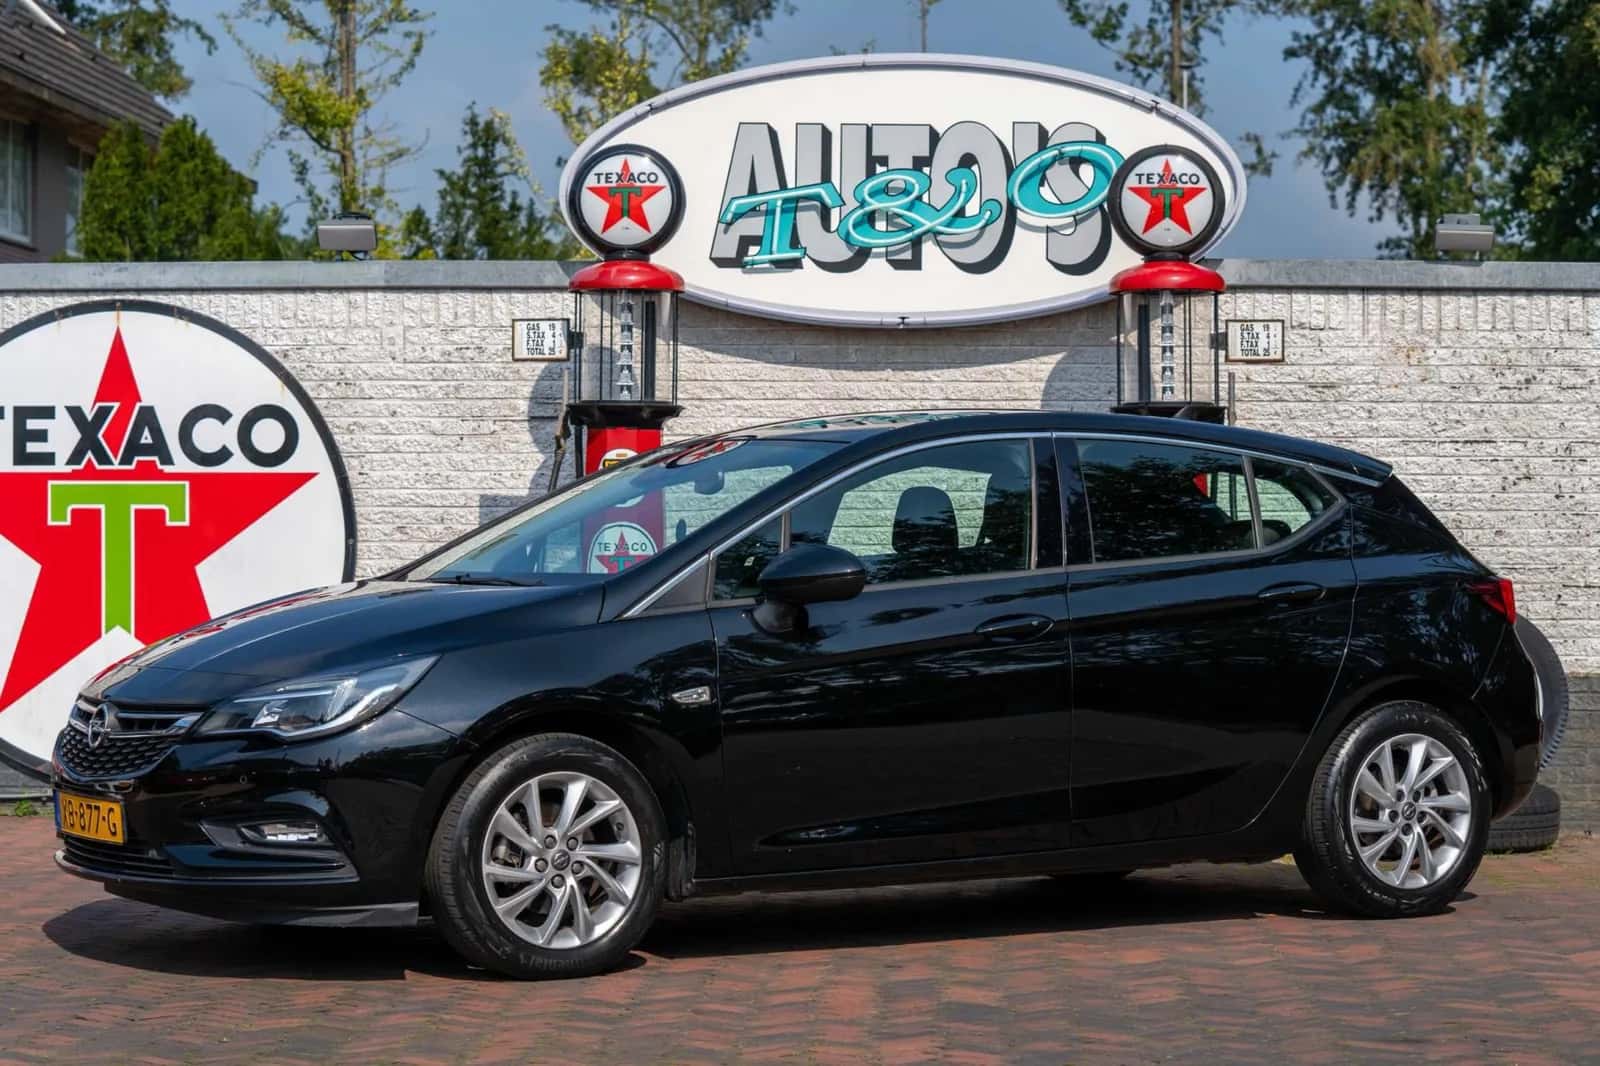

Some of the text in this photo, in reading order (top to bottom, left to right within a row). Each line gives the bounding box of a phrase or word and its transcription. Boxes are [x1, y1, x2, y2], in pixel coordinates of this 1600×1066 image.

[594, 172, 658, 184] TEXACO
[1136, 173, 1200, 185] TEXACO
[527, 347, 546, 355] TOTAL
[1240, 348, 1261, 356] TOTAL
[0, 404, 299, 467] EXACO
[597, 542, 647, 552] TEXACO
[49, 483, 187, 634] T
[63, 799, 117, 836] XB-877-G
